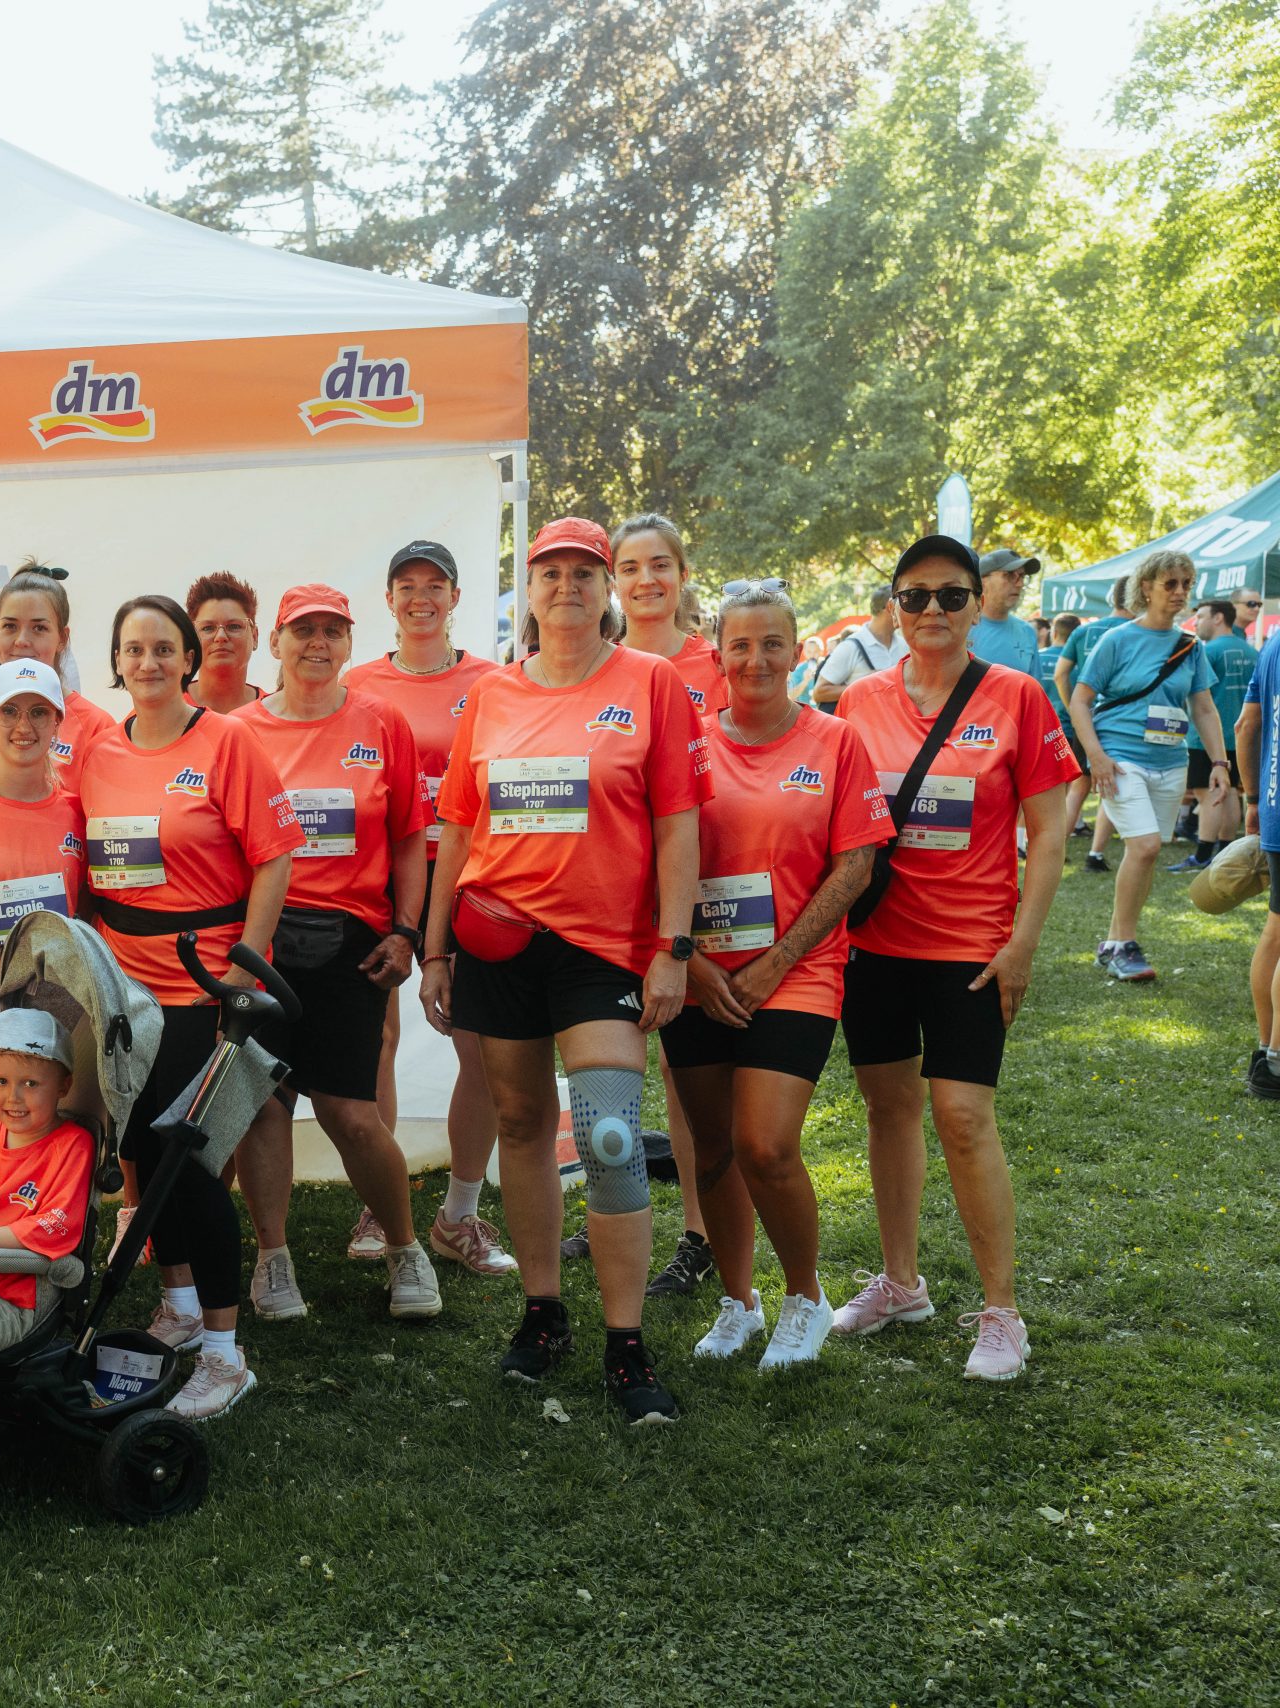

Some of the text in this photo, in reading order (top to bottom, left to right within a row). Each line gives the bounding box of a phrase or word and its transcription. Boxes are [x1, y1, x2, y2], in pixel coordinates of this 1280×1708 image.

[325, 352, 405, 399] dm
[56, 366, 136, 414] dm
[1163, 515, 1271, 557] ITO
[19, 667, 35, 677] dm
[598, 705, 631, 723] dm
[962, 726, 993, 741] dm
[1044, 726, 1063, 744] ARBE
[349, 745, 378, 760] dm
[688, 736, 708, 754] ARBE
[176, 769, 205, 786] dm
[790, 766, 820, 783] dm
[500, 782, 574, 800] Stephanie
[268, 792, 288, 808] ARBE
[524, 800, 545, 808] 1707
[277, 814, 295, 828] LEB
[870, 807, 890, 820] LEB
[65, 834, 82, 849] dm
[104, 840, 129, 855] Sina
[701, 902, 738, 918] Gaby
[712, 919, 731, 928] 1715
[108, 1374, 143, 1393] Marvin
